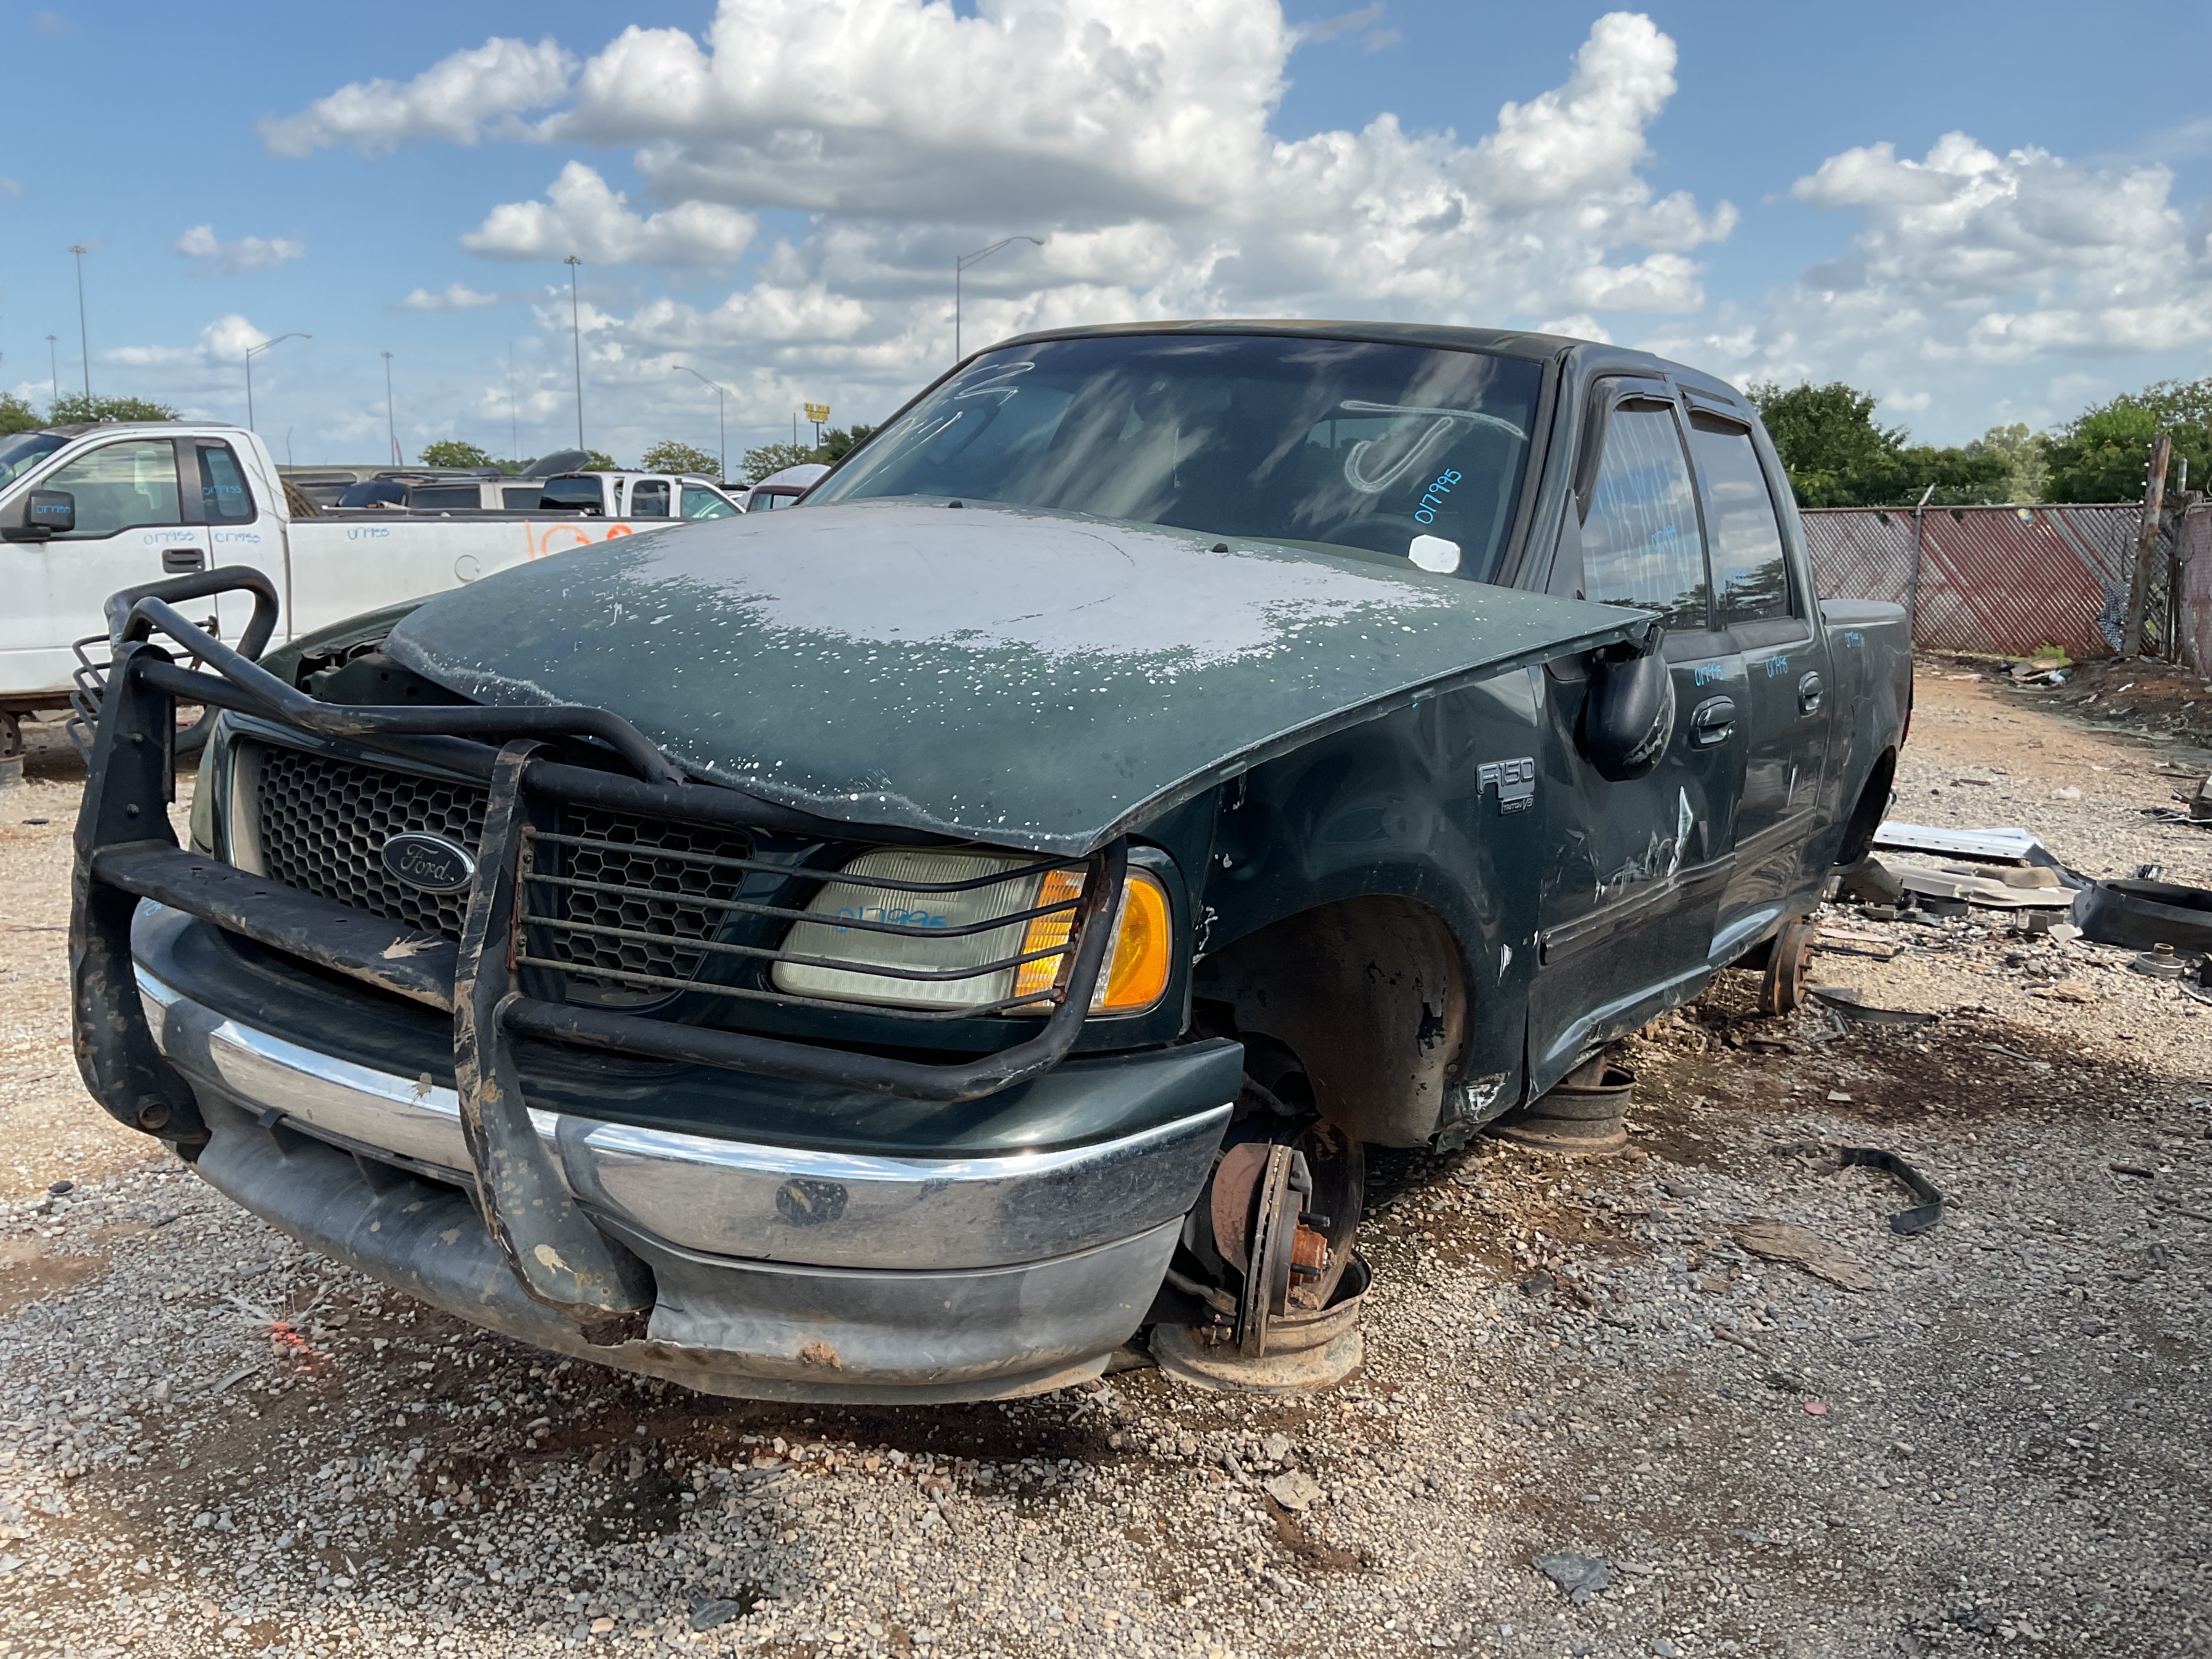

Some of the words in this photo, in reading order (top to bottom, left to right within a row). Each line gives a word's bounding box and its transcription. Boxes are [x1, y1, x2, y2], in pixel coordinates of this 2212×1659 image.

[1414, 468, 1462, 524] 017995
[144, 531, 194, 545] 017955
[214, 533, 261, 543] 017955
[1695, 662, 1723, 686] 017995
[400, 843, 455, 881] Ford
